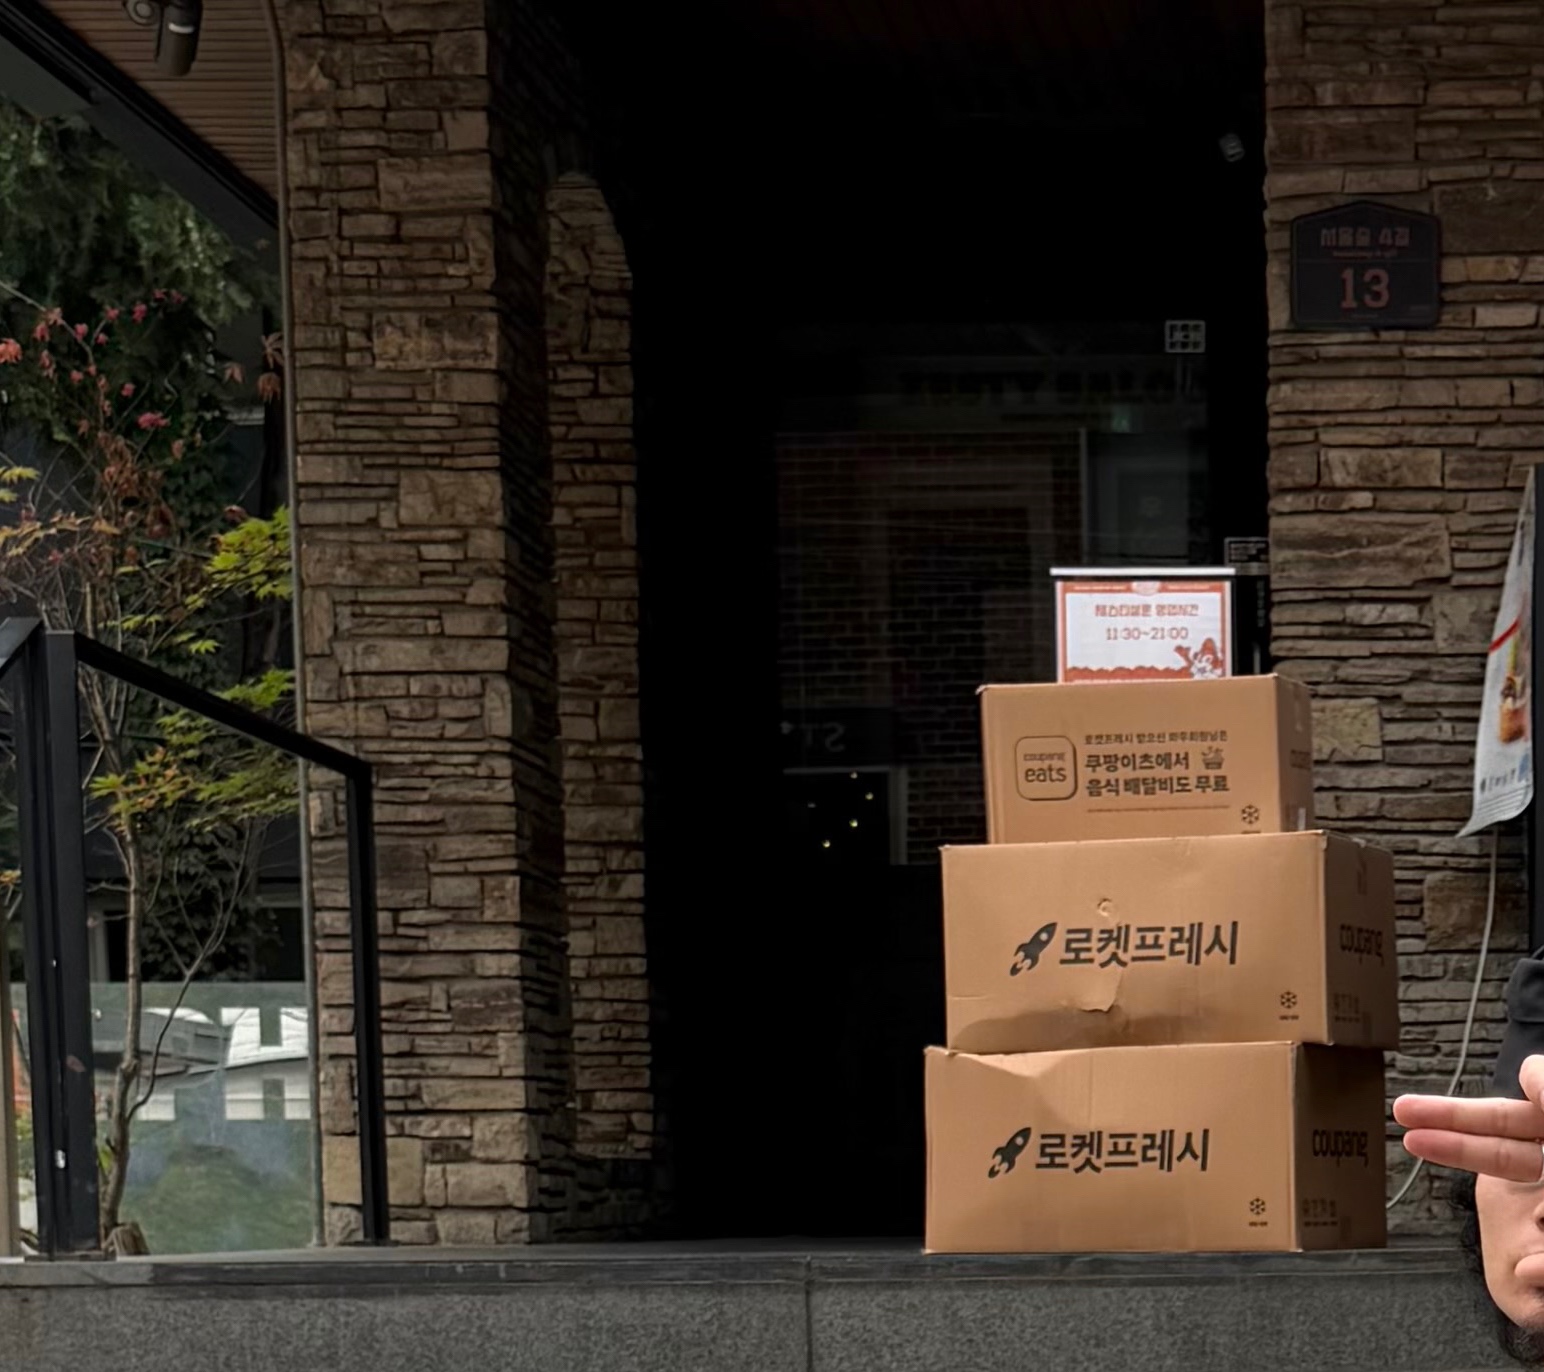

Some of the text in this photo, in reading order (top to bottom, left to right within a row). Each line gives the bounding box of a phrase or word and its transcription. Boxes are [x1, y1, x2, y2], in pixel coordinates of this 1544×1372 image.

[1341, 268, 1390, 309] 13
[1085, 734, 1134, 745] 로켓프레시
[1136, 732, 1167, 744] 받으신
[1023, 752, 1066, 763] coupang
[1085, 752, 1190, 773] 쿠팡이츠에서
[1024, 764, 1068, 783] eats
[1086, 775, 1231, 797] 음식 배달비도 무료
[1059, 921, 1239, 967] 로켓프레시
[1339, 923, 1384, 967] coupang
[1035, 1129, 1210, 1174] 로켓프레시
[1312, 1129, 1370, 1168] coupang
